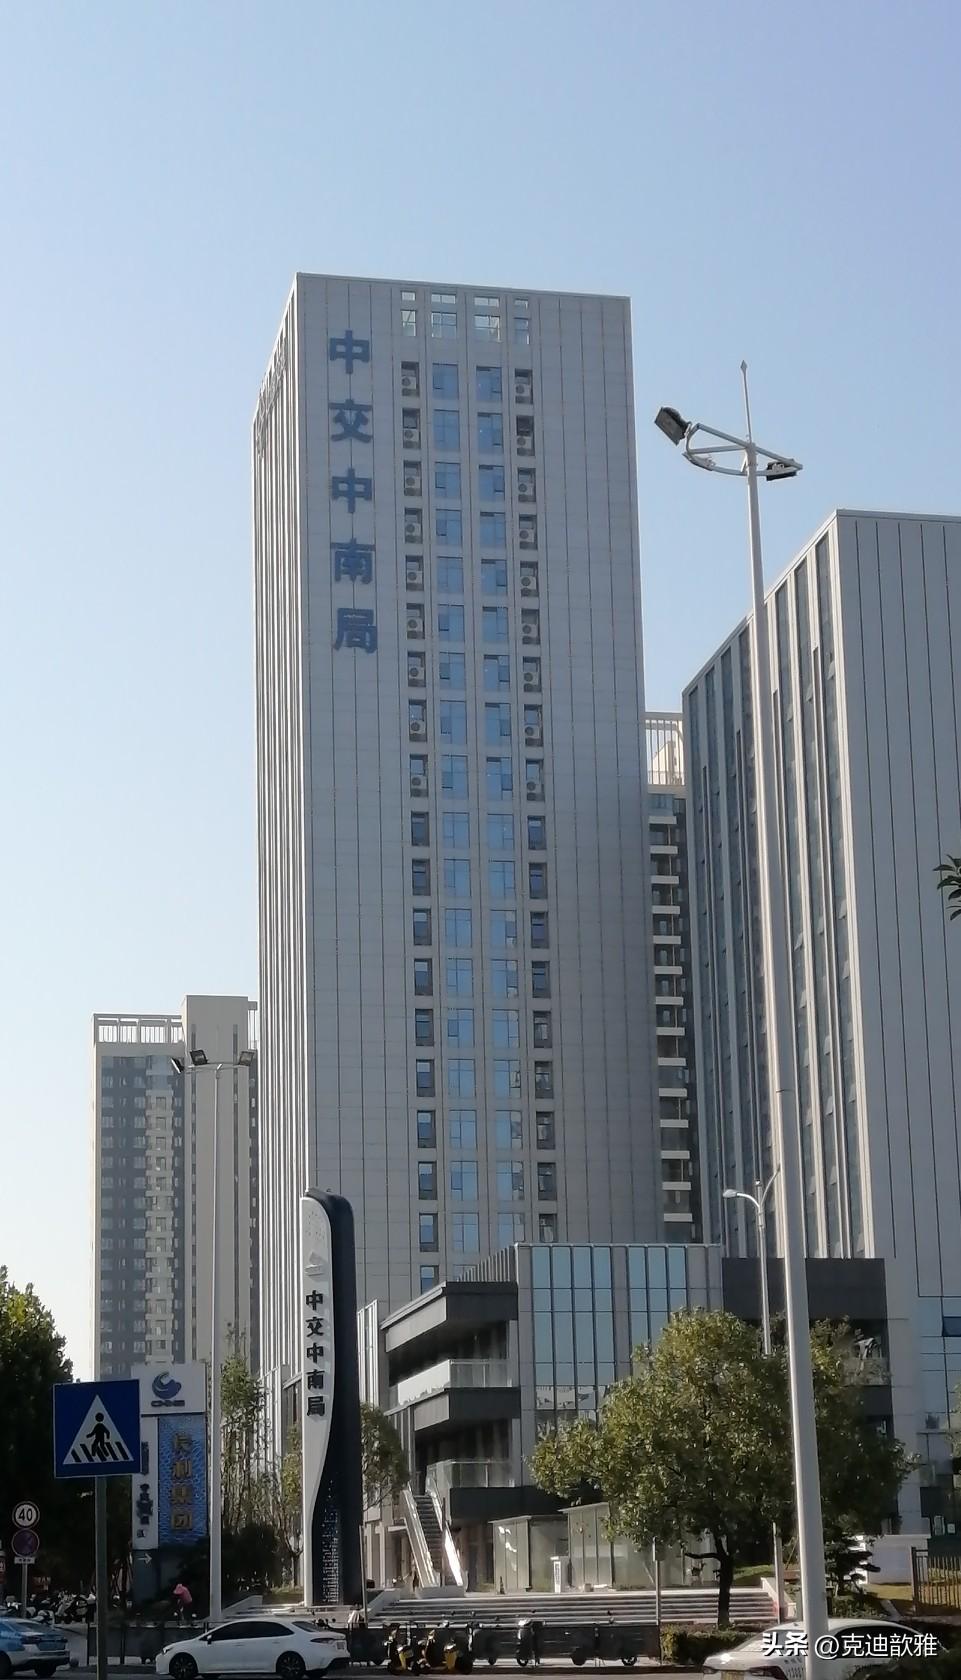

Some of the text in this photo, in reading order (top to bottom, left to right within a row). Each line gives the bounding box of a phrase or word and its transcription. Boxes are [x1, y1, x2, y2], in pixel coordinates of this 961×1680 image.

[329, 330, 378, 653] 中交中南局
[305, 1290, 326, 1417] 中交中南局
[17, 1508, 33, 1521] 40
